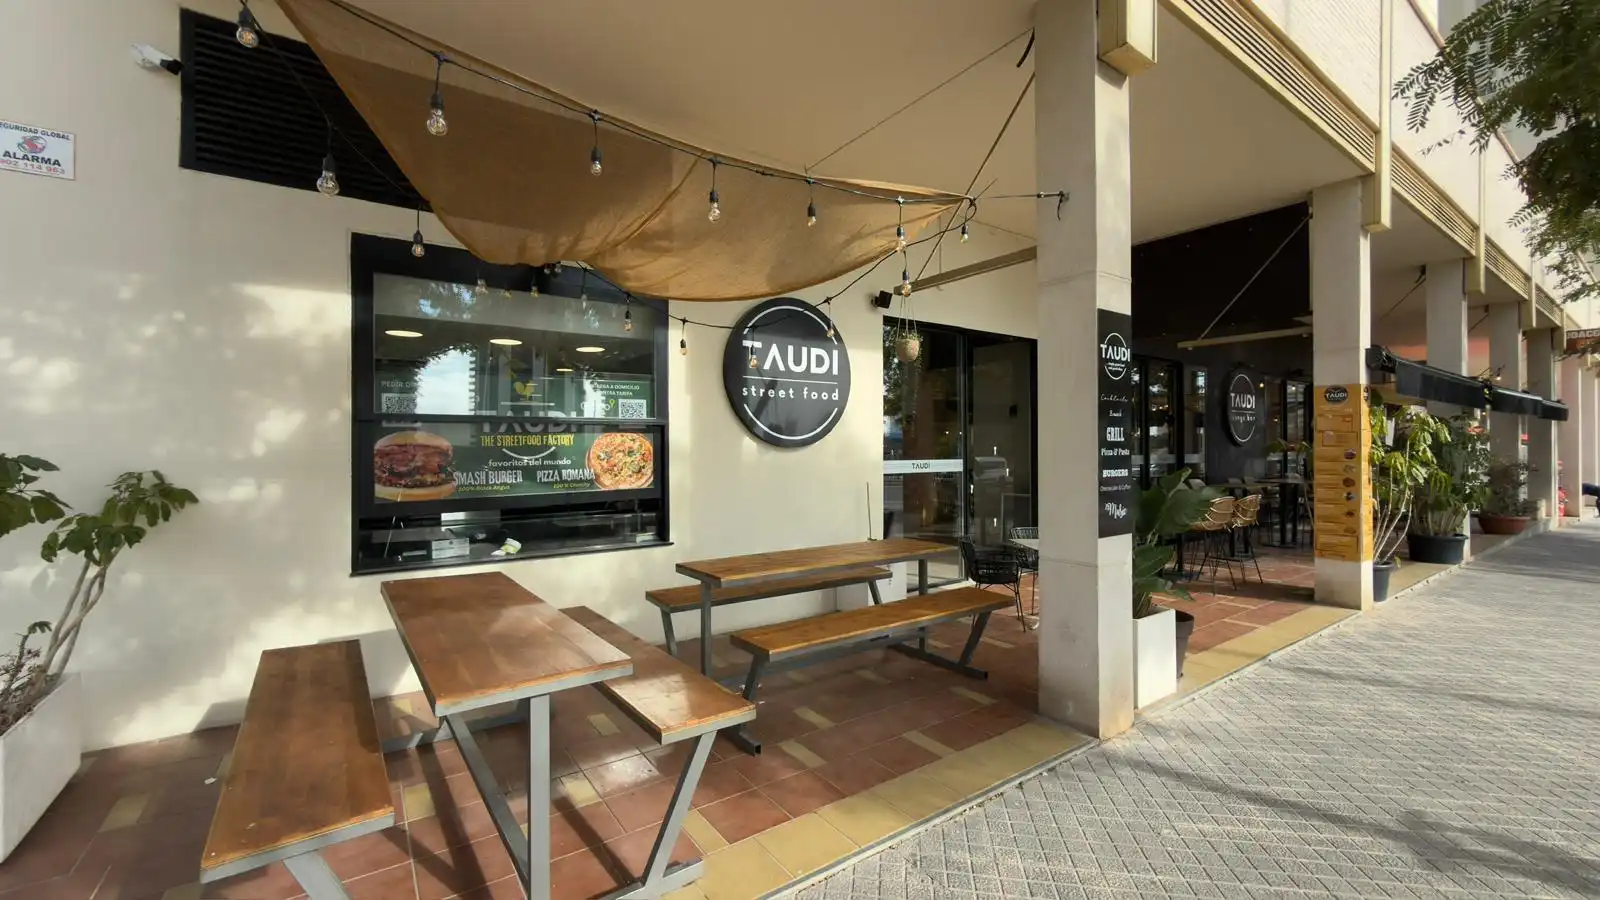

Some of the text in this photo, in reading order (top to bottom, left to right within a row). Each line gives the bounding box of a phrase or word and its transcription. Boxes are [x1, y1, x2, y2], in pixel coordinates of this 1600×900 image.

[41, 130, 70, 140] GLOBAL
[3, 150, 62, 167] ALARMA
[742, 339, 839, 376] TAUDI
[1099, 343, 1131, 362] TAUDI
[742, 385, 839, 401] street food
[1230, 392, 1256, 409] TAUDI
[475, 410, 578, 433] TAUDI
[480, 433, 575, 447] THE STREETFOOD FACTORY
[1106, 427, 1125, 442] GRILL
[488, 457, 572, 468] favoritos del mundo
[911, 462, 931, 470] TAUDI
[453, 469, 523, 486] SMASH BURGER
[537, 468, 596, 483] PIZZA ROMANA
